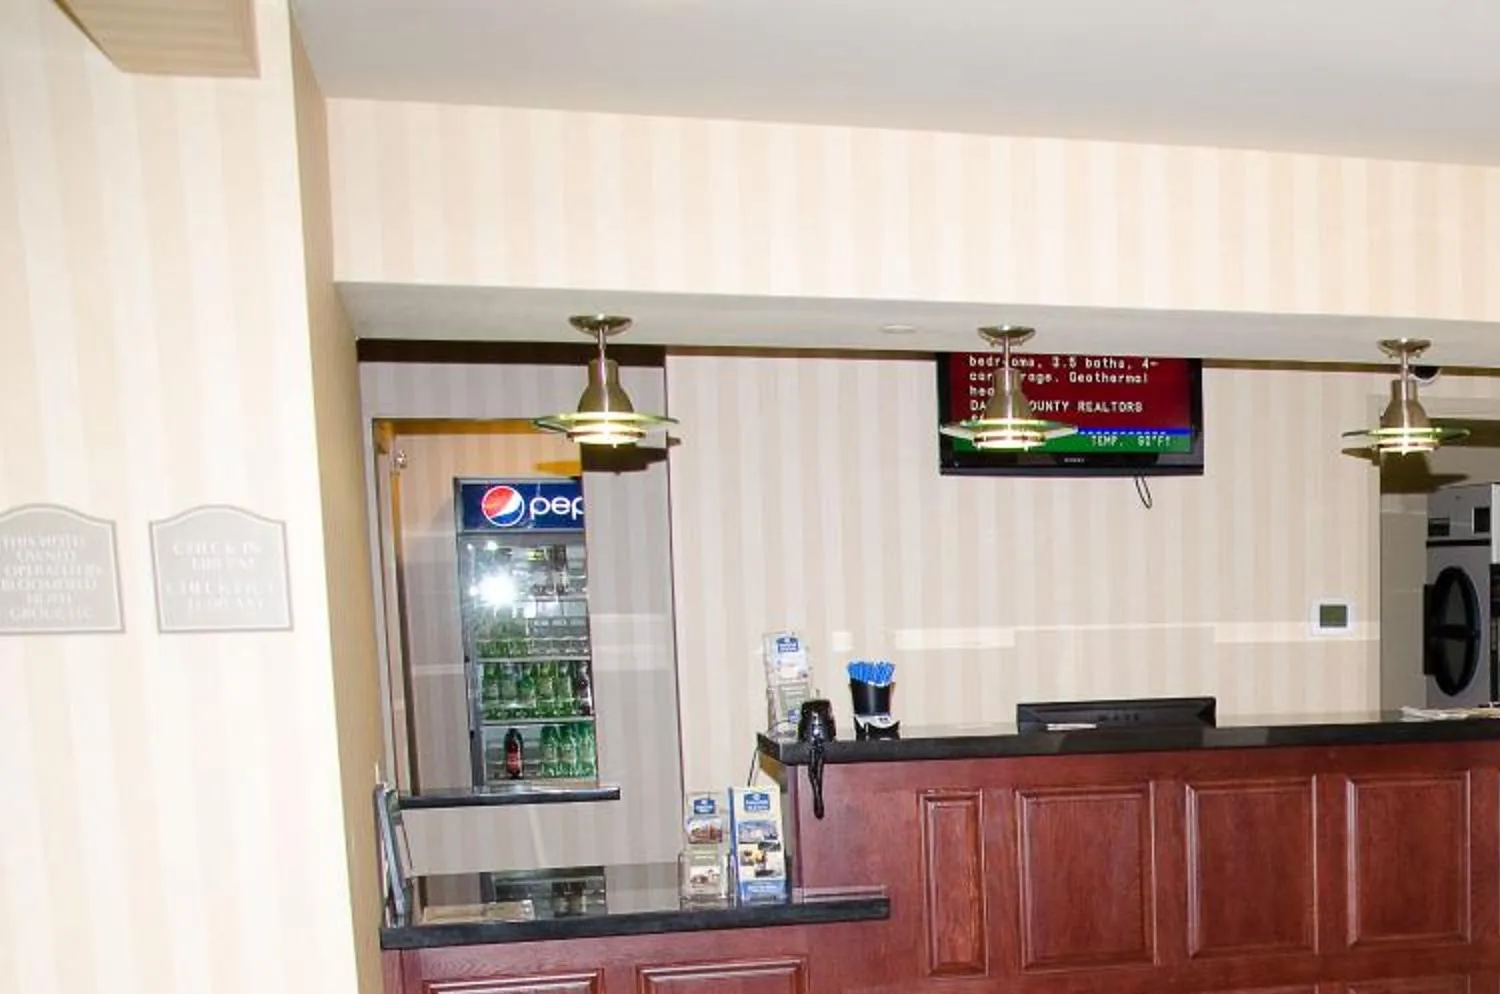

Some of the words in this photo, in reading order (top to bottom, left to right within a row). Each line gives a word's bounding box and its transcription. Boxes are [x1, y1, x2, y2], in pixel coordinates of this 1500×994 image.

[969, 355, 1042, 369] bedroms,
[1069, 371, 1148, 384] Geothermal
[1027, 400, 1070, 412] OUNTY
[1077, 401, 1143, 413] REALTORS
[529, 496, 584, 521] pep
